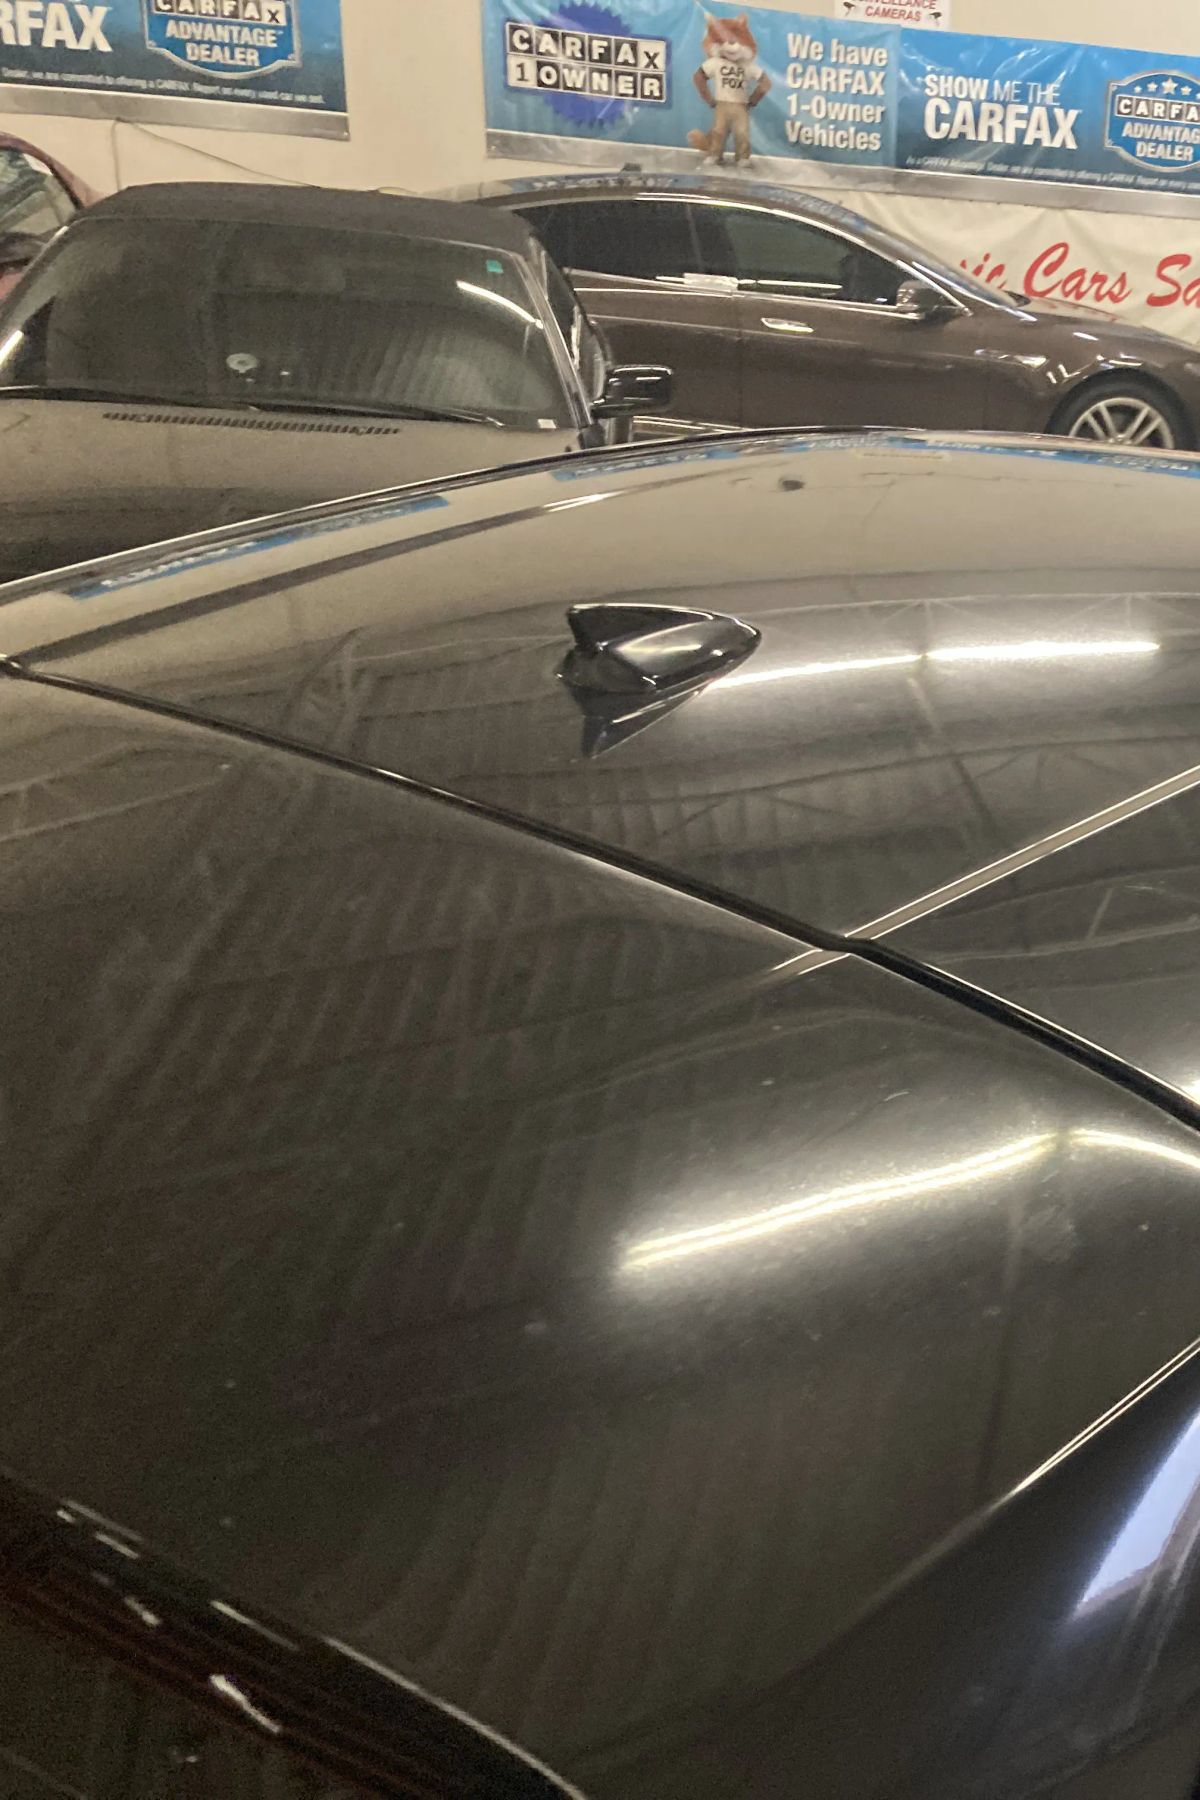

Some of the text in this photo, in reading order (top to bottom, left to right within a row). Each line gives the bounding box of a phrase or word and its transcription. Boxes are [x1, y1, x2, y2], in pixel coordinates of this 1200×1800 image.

[156, 0, 281, 24] CARFAX
[865, 6, 921, 21] CAMERAS
[166, 20, 278, 48] ADVANTAGE
[512, 28, 660, 69] CARFAX
[186, 42, 260, 66] DEALER
[786, 33, 888, 66] We have
[537, 65, 661, 98] OWNER
[720, 66, 745, 77] CAR
[722, 77, 745, 89] FOX
[786, 64, 886, 96] CARFAX
[924, 74, 1060, 106] SHOW ME THE
[787, 95, 884, 123] 1-Owner
[785, 120, 882, 151] Vehicles
[924, 101, 1079, 149] CARFAX
[1135, 142, 1194, 162] DEALER
[1023, 242, 1134, 304] Cars
